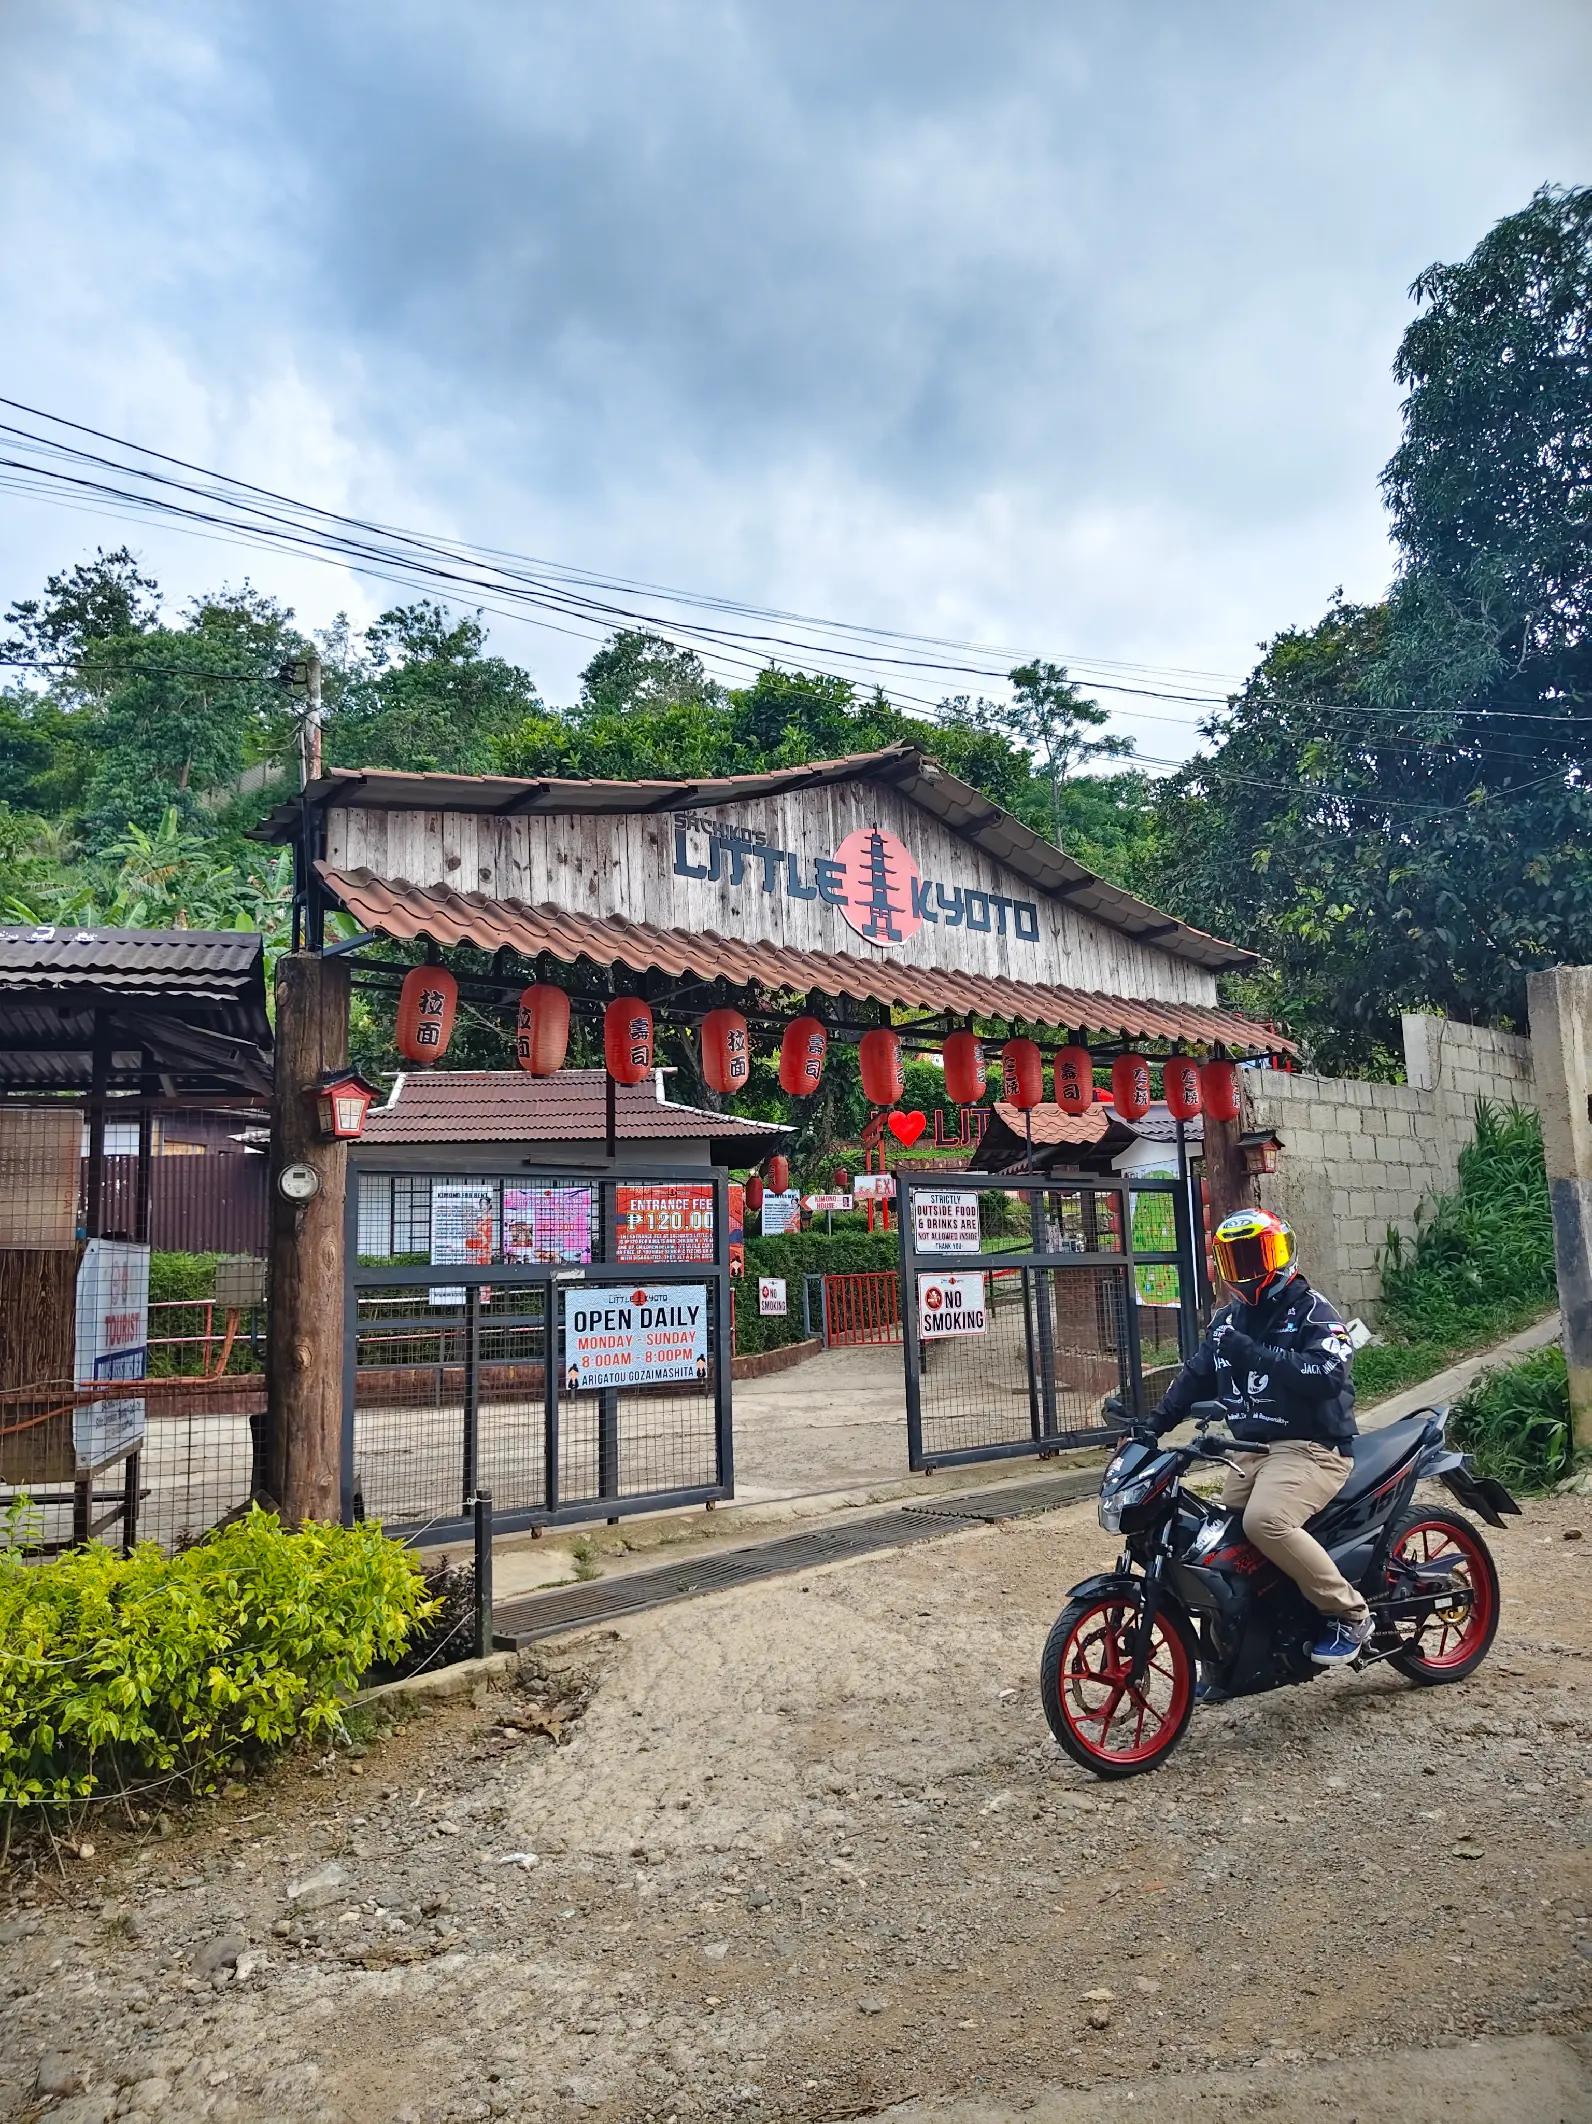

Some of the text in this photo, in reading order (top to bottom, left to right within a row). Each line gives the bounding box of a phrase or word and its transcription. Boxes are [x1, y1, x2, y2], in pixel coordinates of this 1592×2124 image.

[675, 813, 766, 847] SACHIKO'S
[674, 829, 1040, 942] LITTLE KYOTO
[875, 1178, 895, 1195] EXI
[630, 1198, 713, 1211] ENTRANCE FEE
[930, 1194, 961, 1204] STRICTLY
[917, 1205, 976, 1216] OUTSIDE FOOD
[927, 1219, 958, 1229] DRINKS
[960, 1219, 977, 1230] ARE
[770, 1287, 777, 1299] NO
[944, 1291, 962, 1309] NO
[761, 1300, 786, 1312] SMOKING
[574, 1305, 700, 1333] OPEN DAILY
[924, 1310, 984, 1332] SMOKING
[577, 1335, 633, 1350] MONDAY
[646, 1331, 696, 1346] SUNDAY
[645, 1348, 693, 1363] 8:00PM
[581, 1366, 694, 1386] ARIGATOU GOZAIMASHITA
[1300, 1362, 1321, 1375] JACK
[1195, 1518, 1225, 1551] SUZUKI
